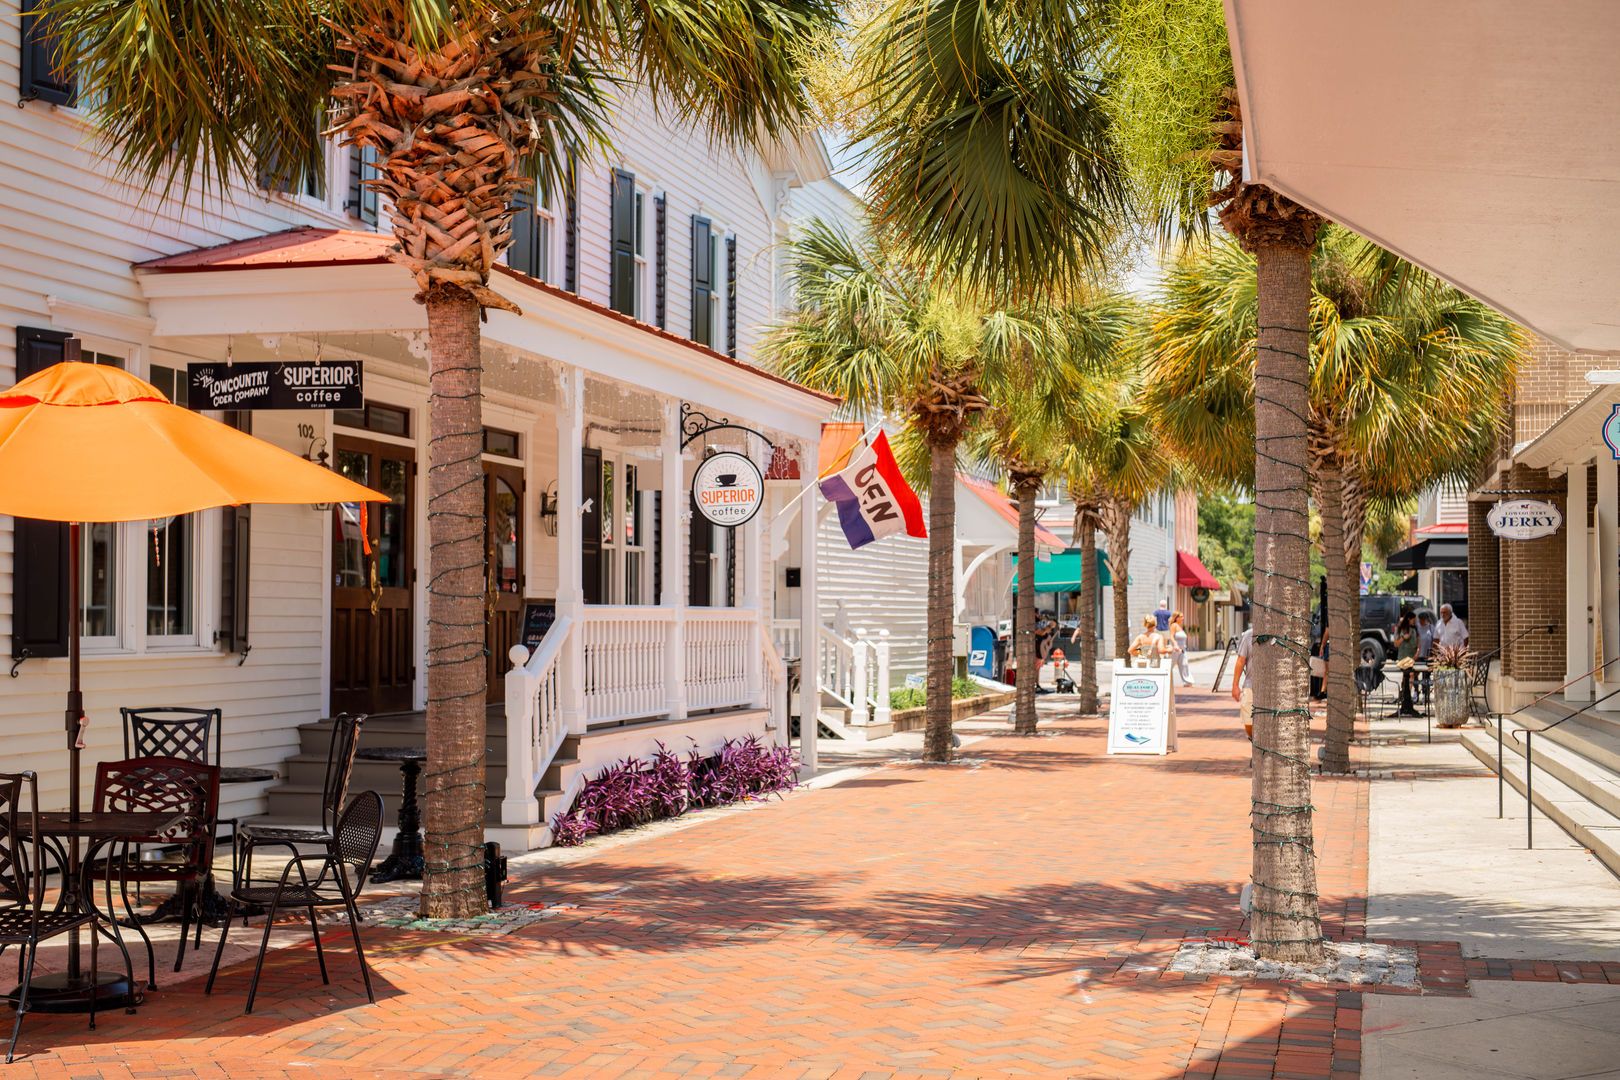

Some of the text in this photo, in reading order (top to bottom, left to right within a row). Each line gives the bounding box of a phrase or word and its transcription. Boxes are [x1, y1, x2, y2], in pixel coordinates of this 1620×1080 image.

[200, 375, 214, 388] The
[283, 366, 354, 386] SUPERIOR
[210, 371, 269, 398] LOWCOUNTRY
[213, 386, 270, 407] CIDER COMPANY
[296, 390, 341, 402] coffee
[297, 423, 315, 439] 102
[701, 488, 755, 504] SUPERIOR
[854, 463, 899, 523] OEN
[712, 507, 746, 516] coffee
[1495, 516, 1556, 528] JERKY
